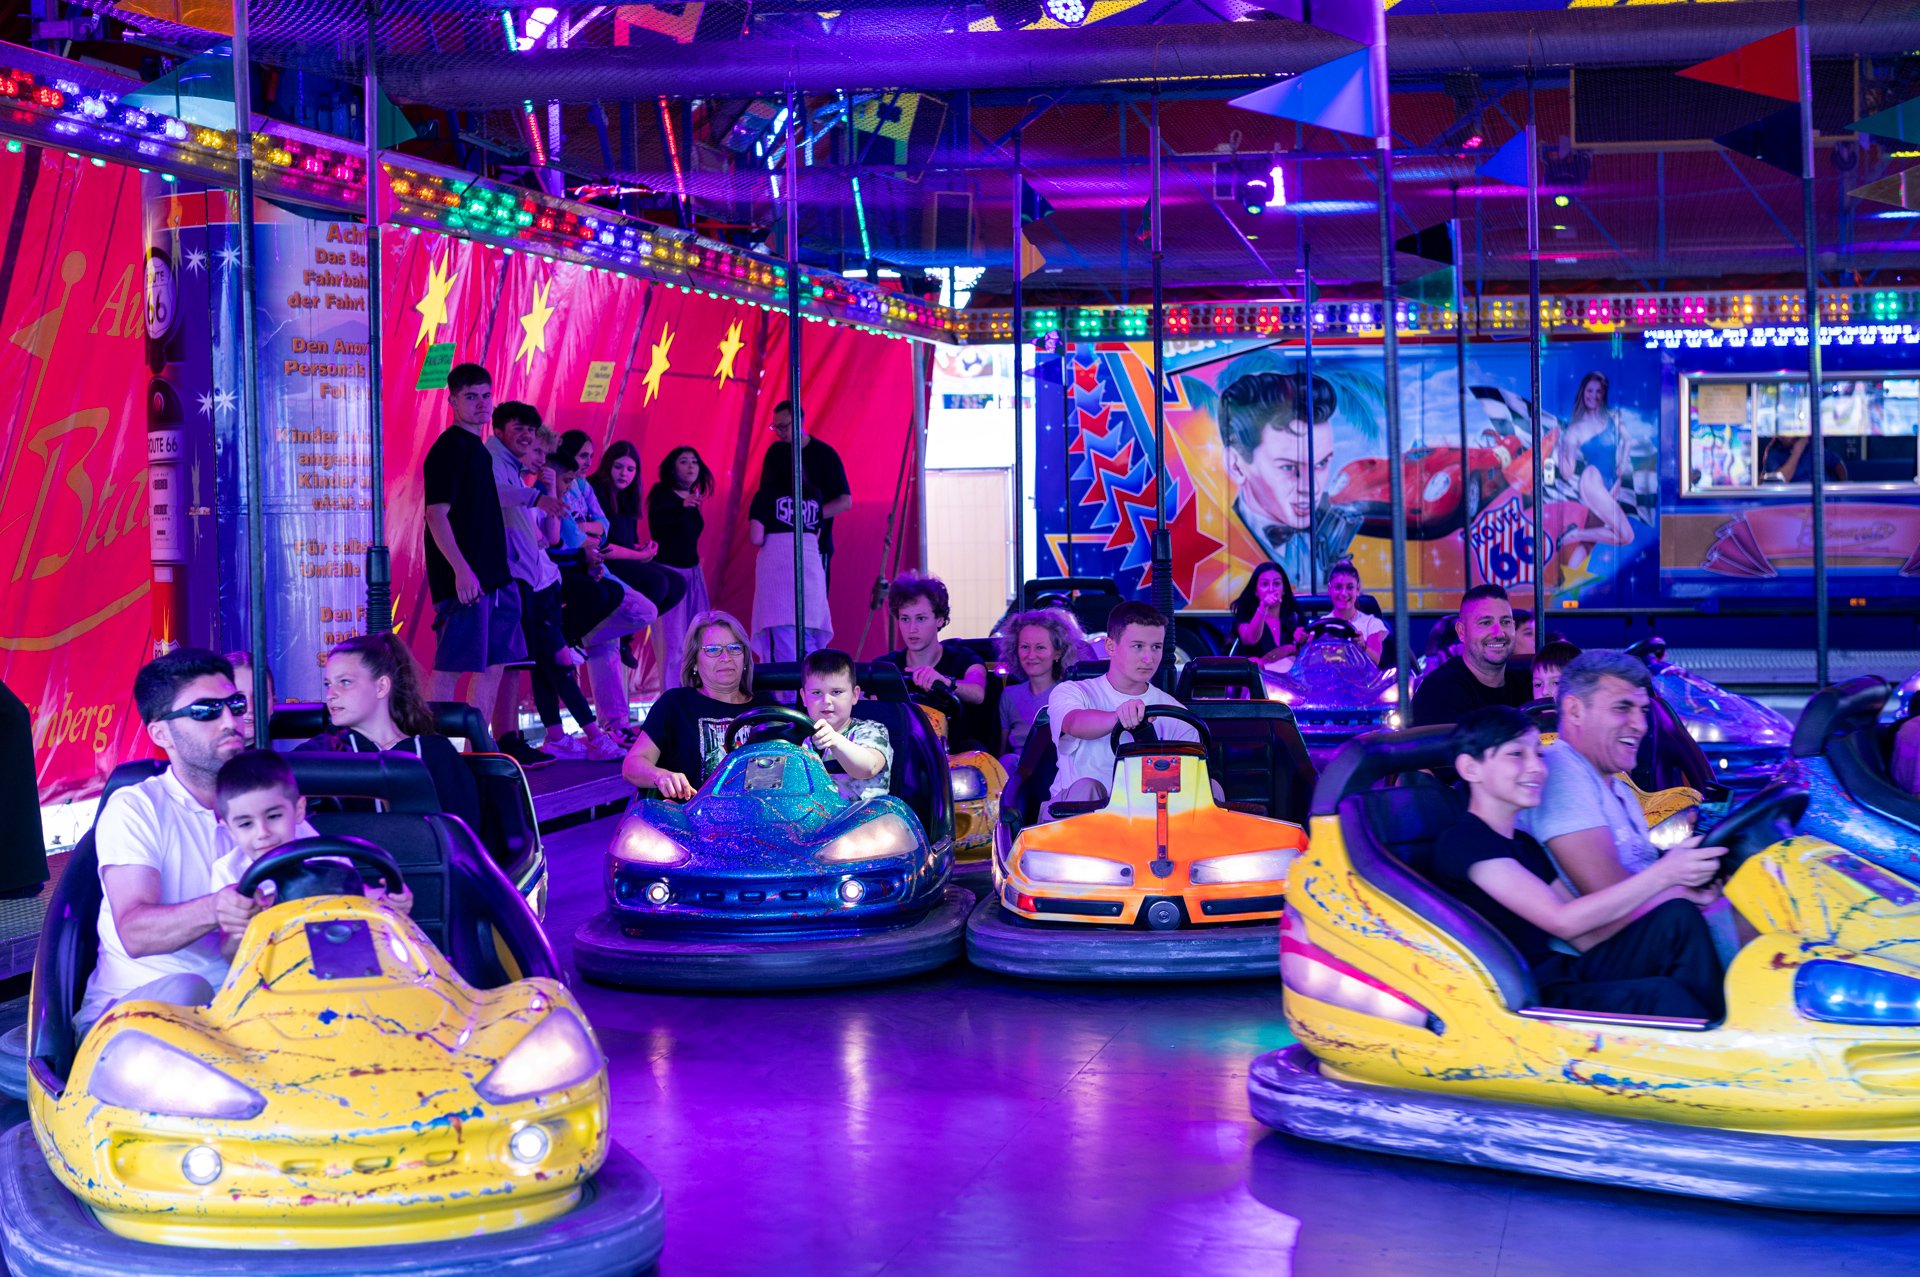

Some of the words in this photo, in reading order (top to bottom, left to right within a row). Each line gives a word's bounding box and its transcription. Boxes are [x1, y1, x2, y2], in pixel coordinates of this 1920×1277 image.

[315, 248, 346, 265] Das
[349, 250, 368, 267] Be
[303, 270, 369, 289] Fahrbah
[88, 263, 145, 340] Au
[147, 289, 168, 326] 66
[287, 291, 321, 308] der
[325, 293, 366, 311] Fahrt
[291, 337, 329, 354] Den
[283, 360, 367, 378] Personals
[275, 426, 340, 444] Kinder
[166, 437, 178, 452] 66
[298, 471, 356, 488] Kinder
[313, 494, 356, 511] nicht
[1471, 508, 1520, 548] ROUTE
[294, 538, 327, 556] Für
[1489, 525, 1534, 581] 66
[300, 560, 361, 579] Unfälle
[320, 607, 352, 623] Den
